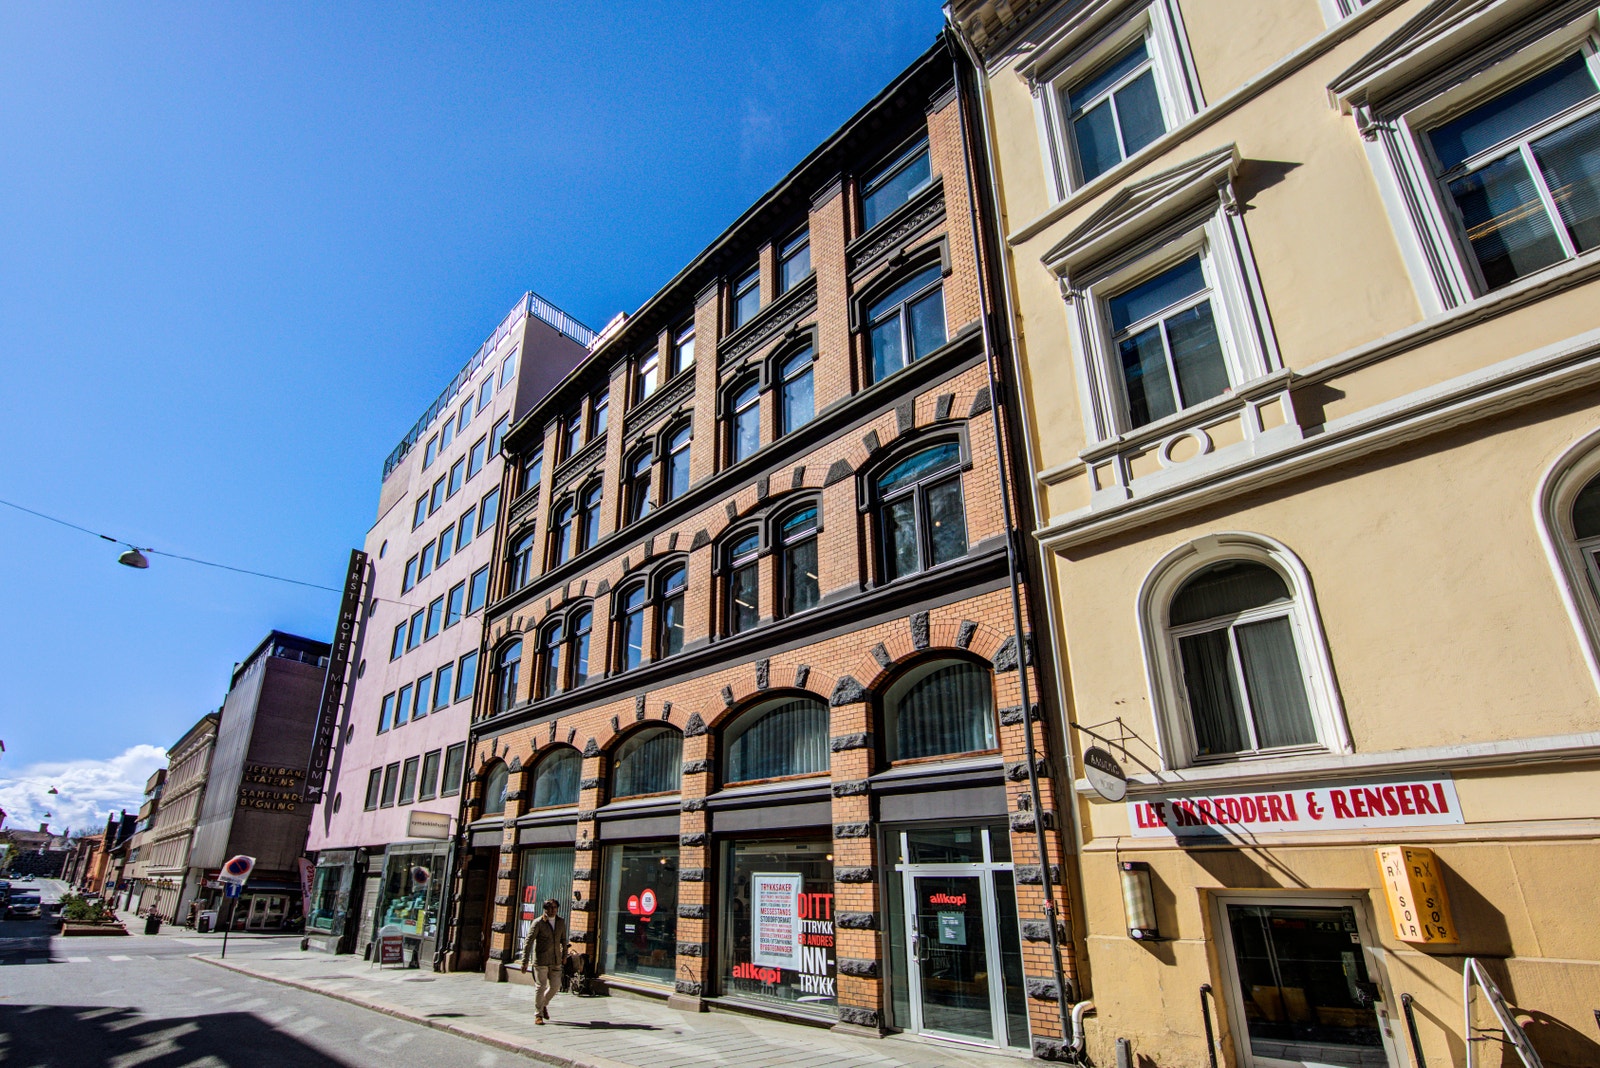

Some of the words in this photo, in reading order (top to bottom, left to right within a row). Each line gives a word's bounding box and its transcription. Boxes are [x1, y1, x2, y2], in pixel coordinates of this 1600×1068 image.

[349, 553, 362, 600] FIRST
[337, 611, 352, 661] HOTEL
[311, 673, 341, 779] MILLENNIUM
[240, 798, 295, 811] BYGNING
[1135, 801, 1168, 829] LEE
[1172, 793, 1299, 827] SKREDDERI
[1305, 792, 1325, 820] &
[1330, 782, 1450, 819] RENSERI
[760, 883, 792, 892] TRYKKSAKER
[1381, 852, 1418, 937] FRISØR
[1405, 850, 1447, 938] FRISØR
[797, 892, 834, 920] DITT
[930, 893, 967, 906] allkopi
[760, 907, 792, 917] MESSESTANDS
[798, 918, 834, 935] UTTRYKK
[797, 933, 807, 945] ER
[807, 934, 834, 948] ANDRES
[798, 946, 835, 976] INN-
[733, 962, 781, 985] allkopi
[799, 974, 836, 996] TRYKK
[734, 978, 778, 996] NetPrint
